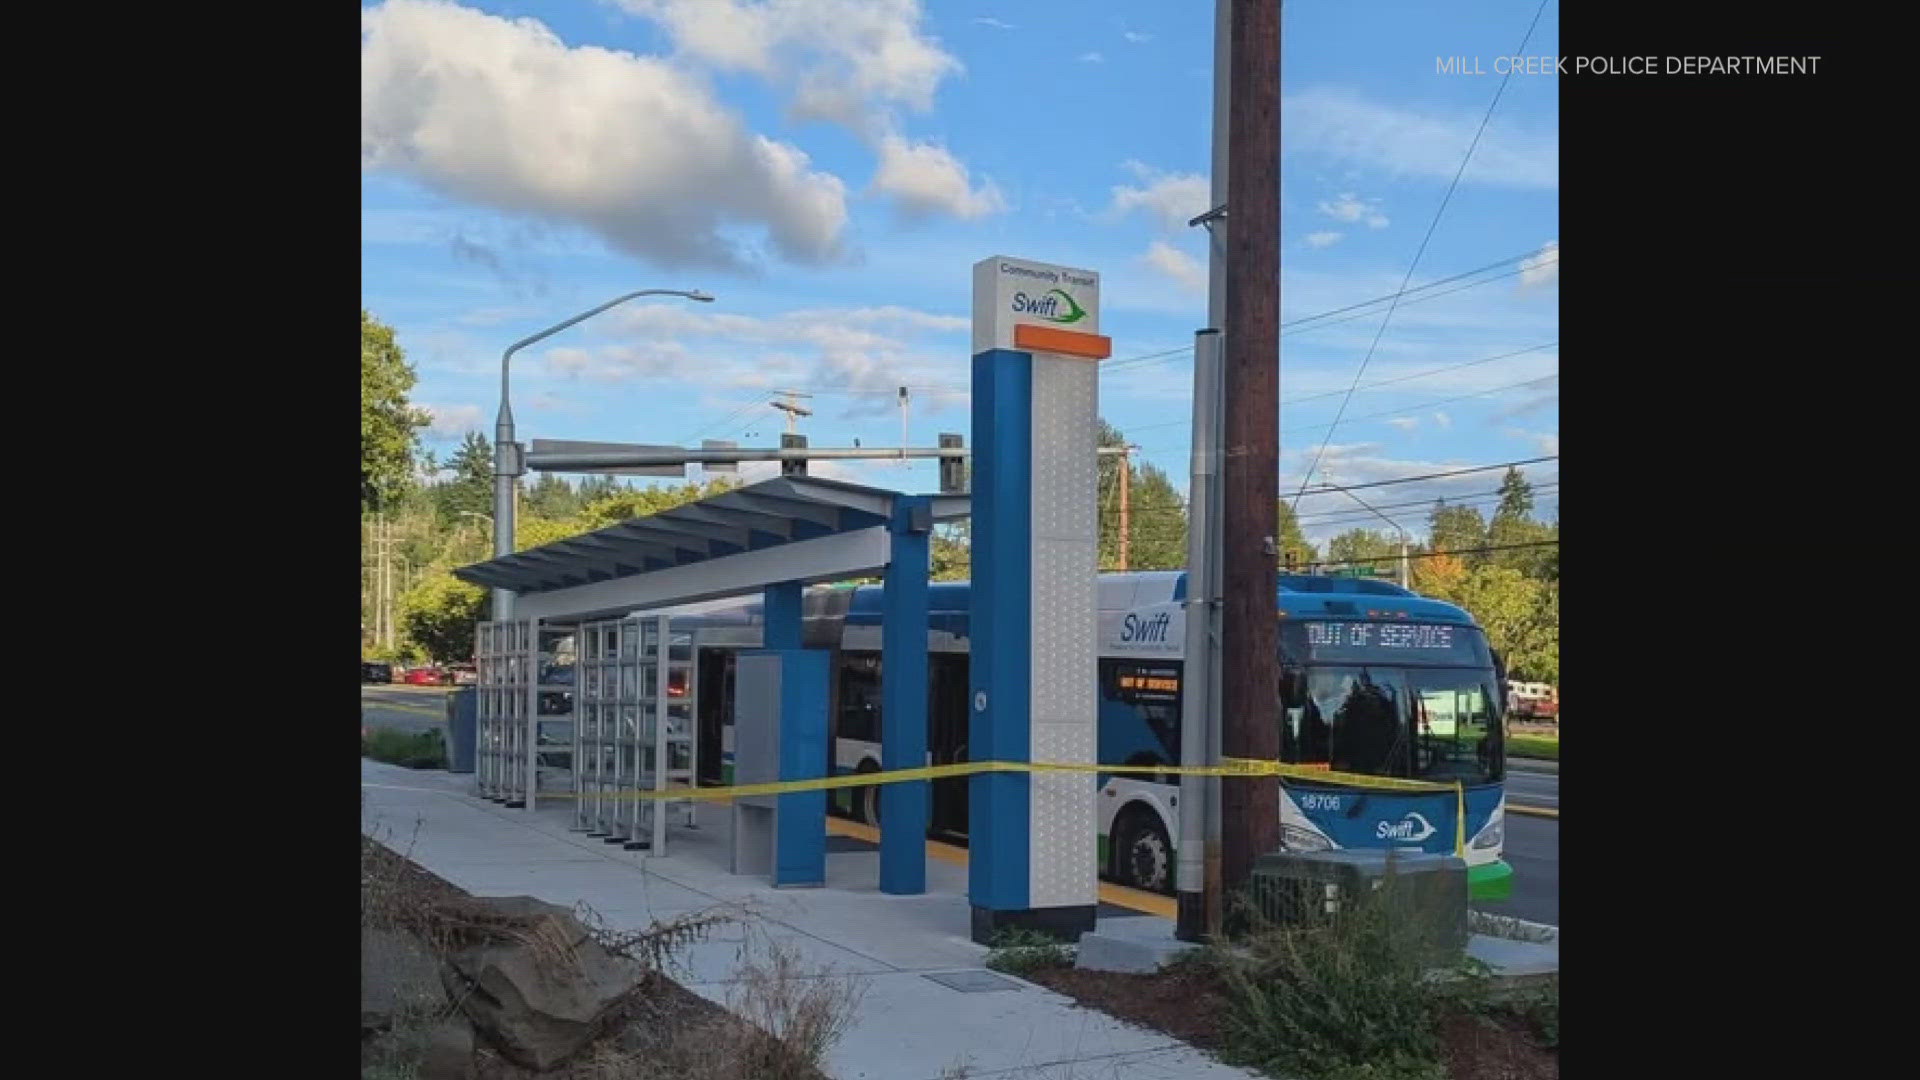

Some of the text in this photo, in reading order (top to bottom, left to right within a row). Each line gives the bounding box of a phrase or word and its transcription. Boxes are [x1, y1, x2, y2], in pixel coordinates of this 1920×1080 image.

[1000, 263, 1095, 286] Community Transit
[1011, 291, 1058, 316] Swift
[1120, 612, 1171, 642] Swift
[1307, 623, 1453, 648] OUT OF SERVICE
[1301, 793, 1341, 811] 18706
[1376, 820, 1414, 839] Swift
